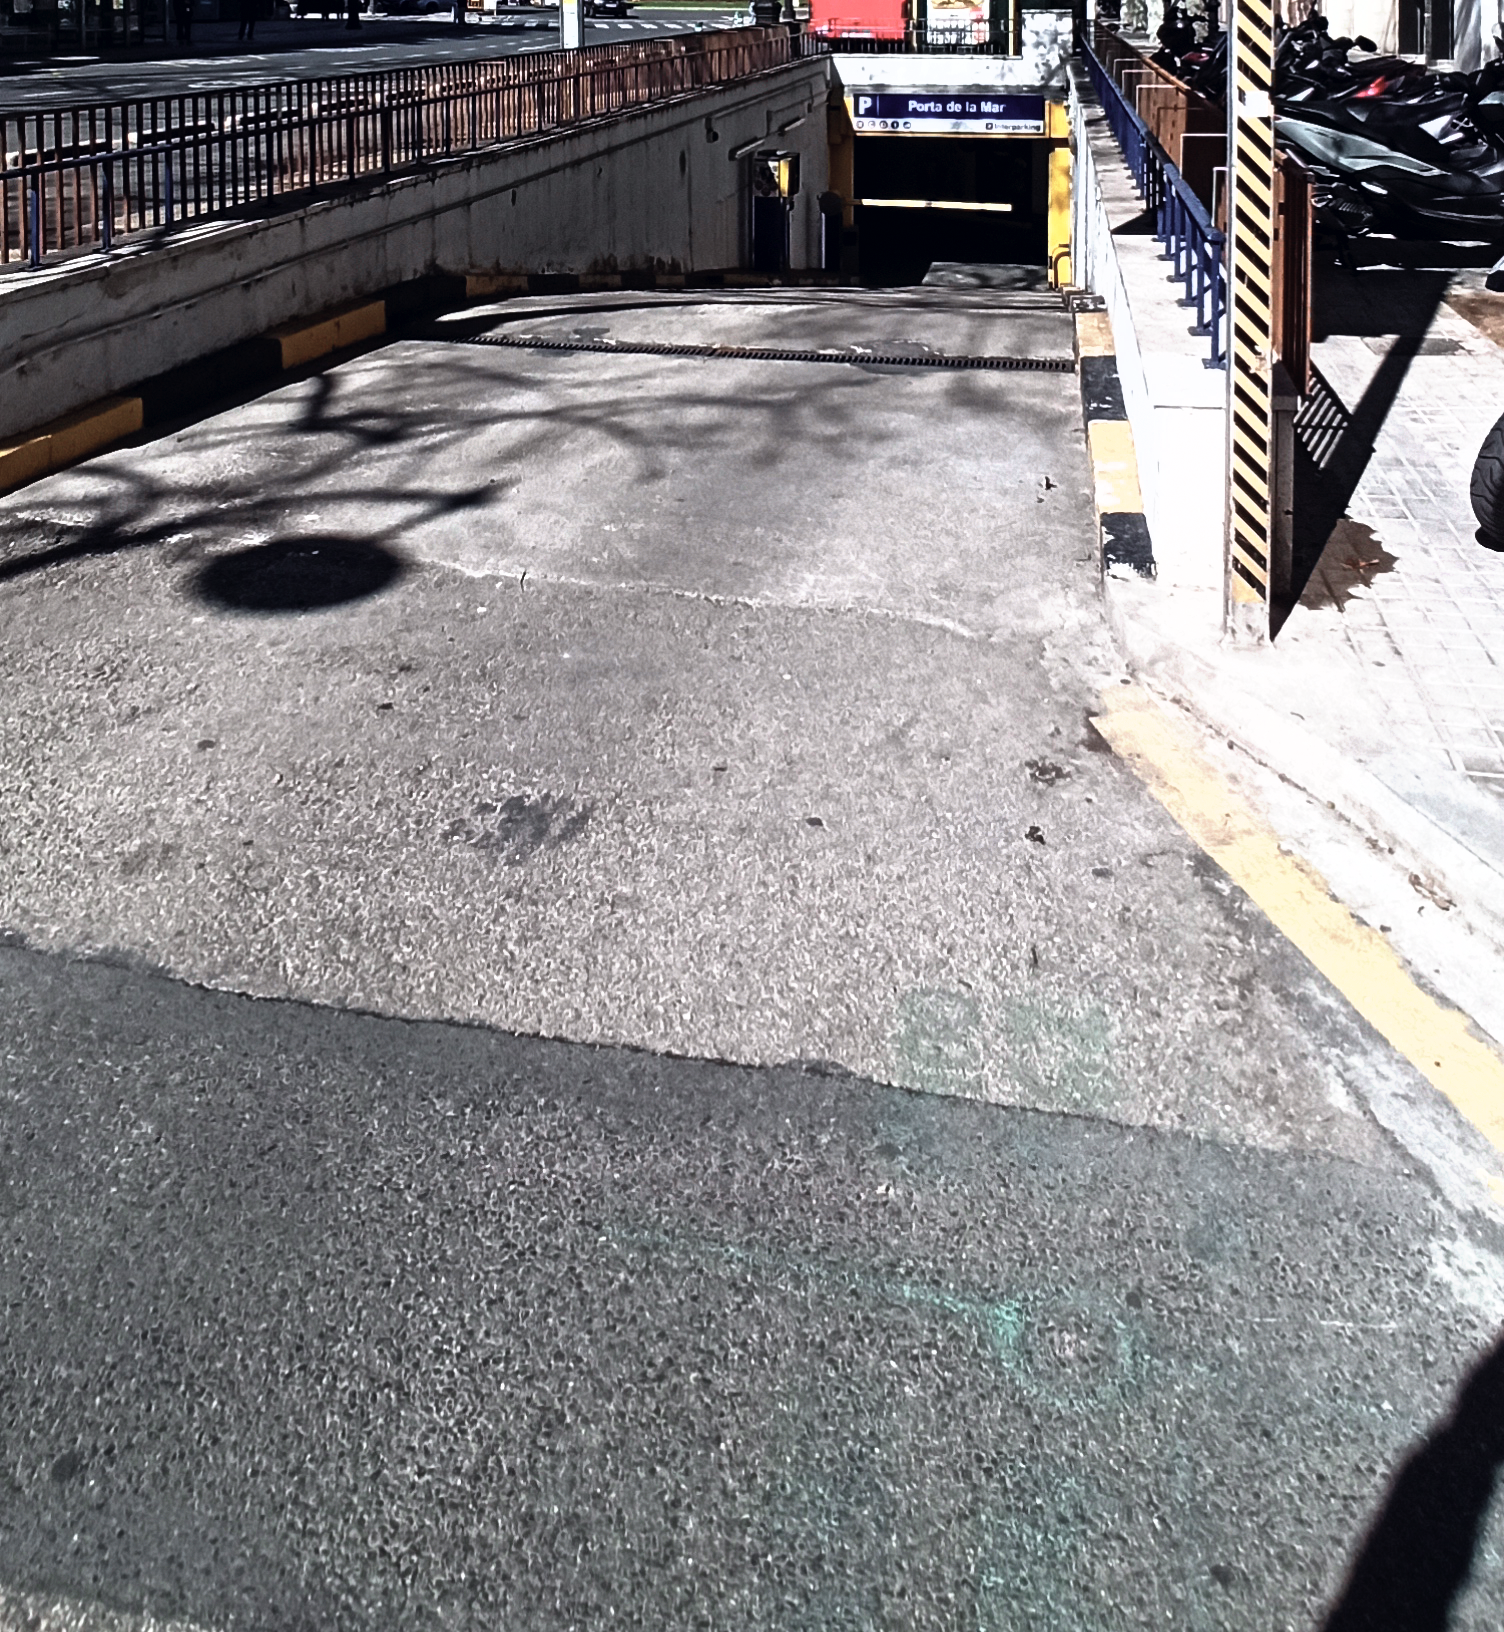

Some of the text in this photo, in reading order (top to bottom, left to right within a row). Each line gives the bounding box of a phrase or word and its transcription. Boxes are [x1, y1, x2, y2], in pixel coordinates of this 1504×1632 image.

[858, 96, 872, 115] P
[908, 100, 1006, 113] Porta de la Mar
